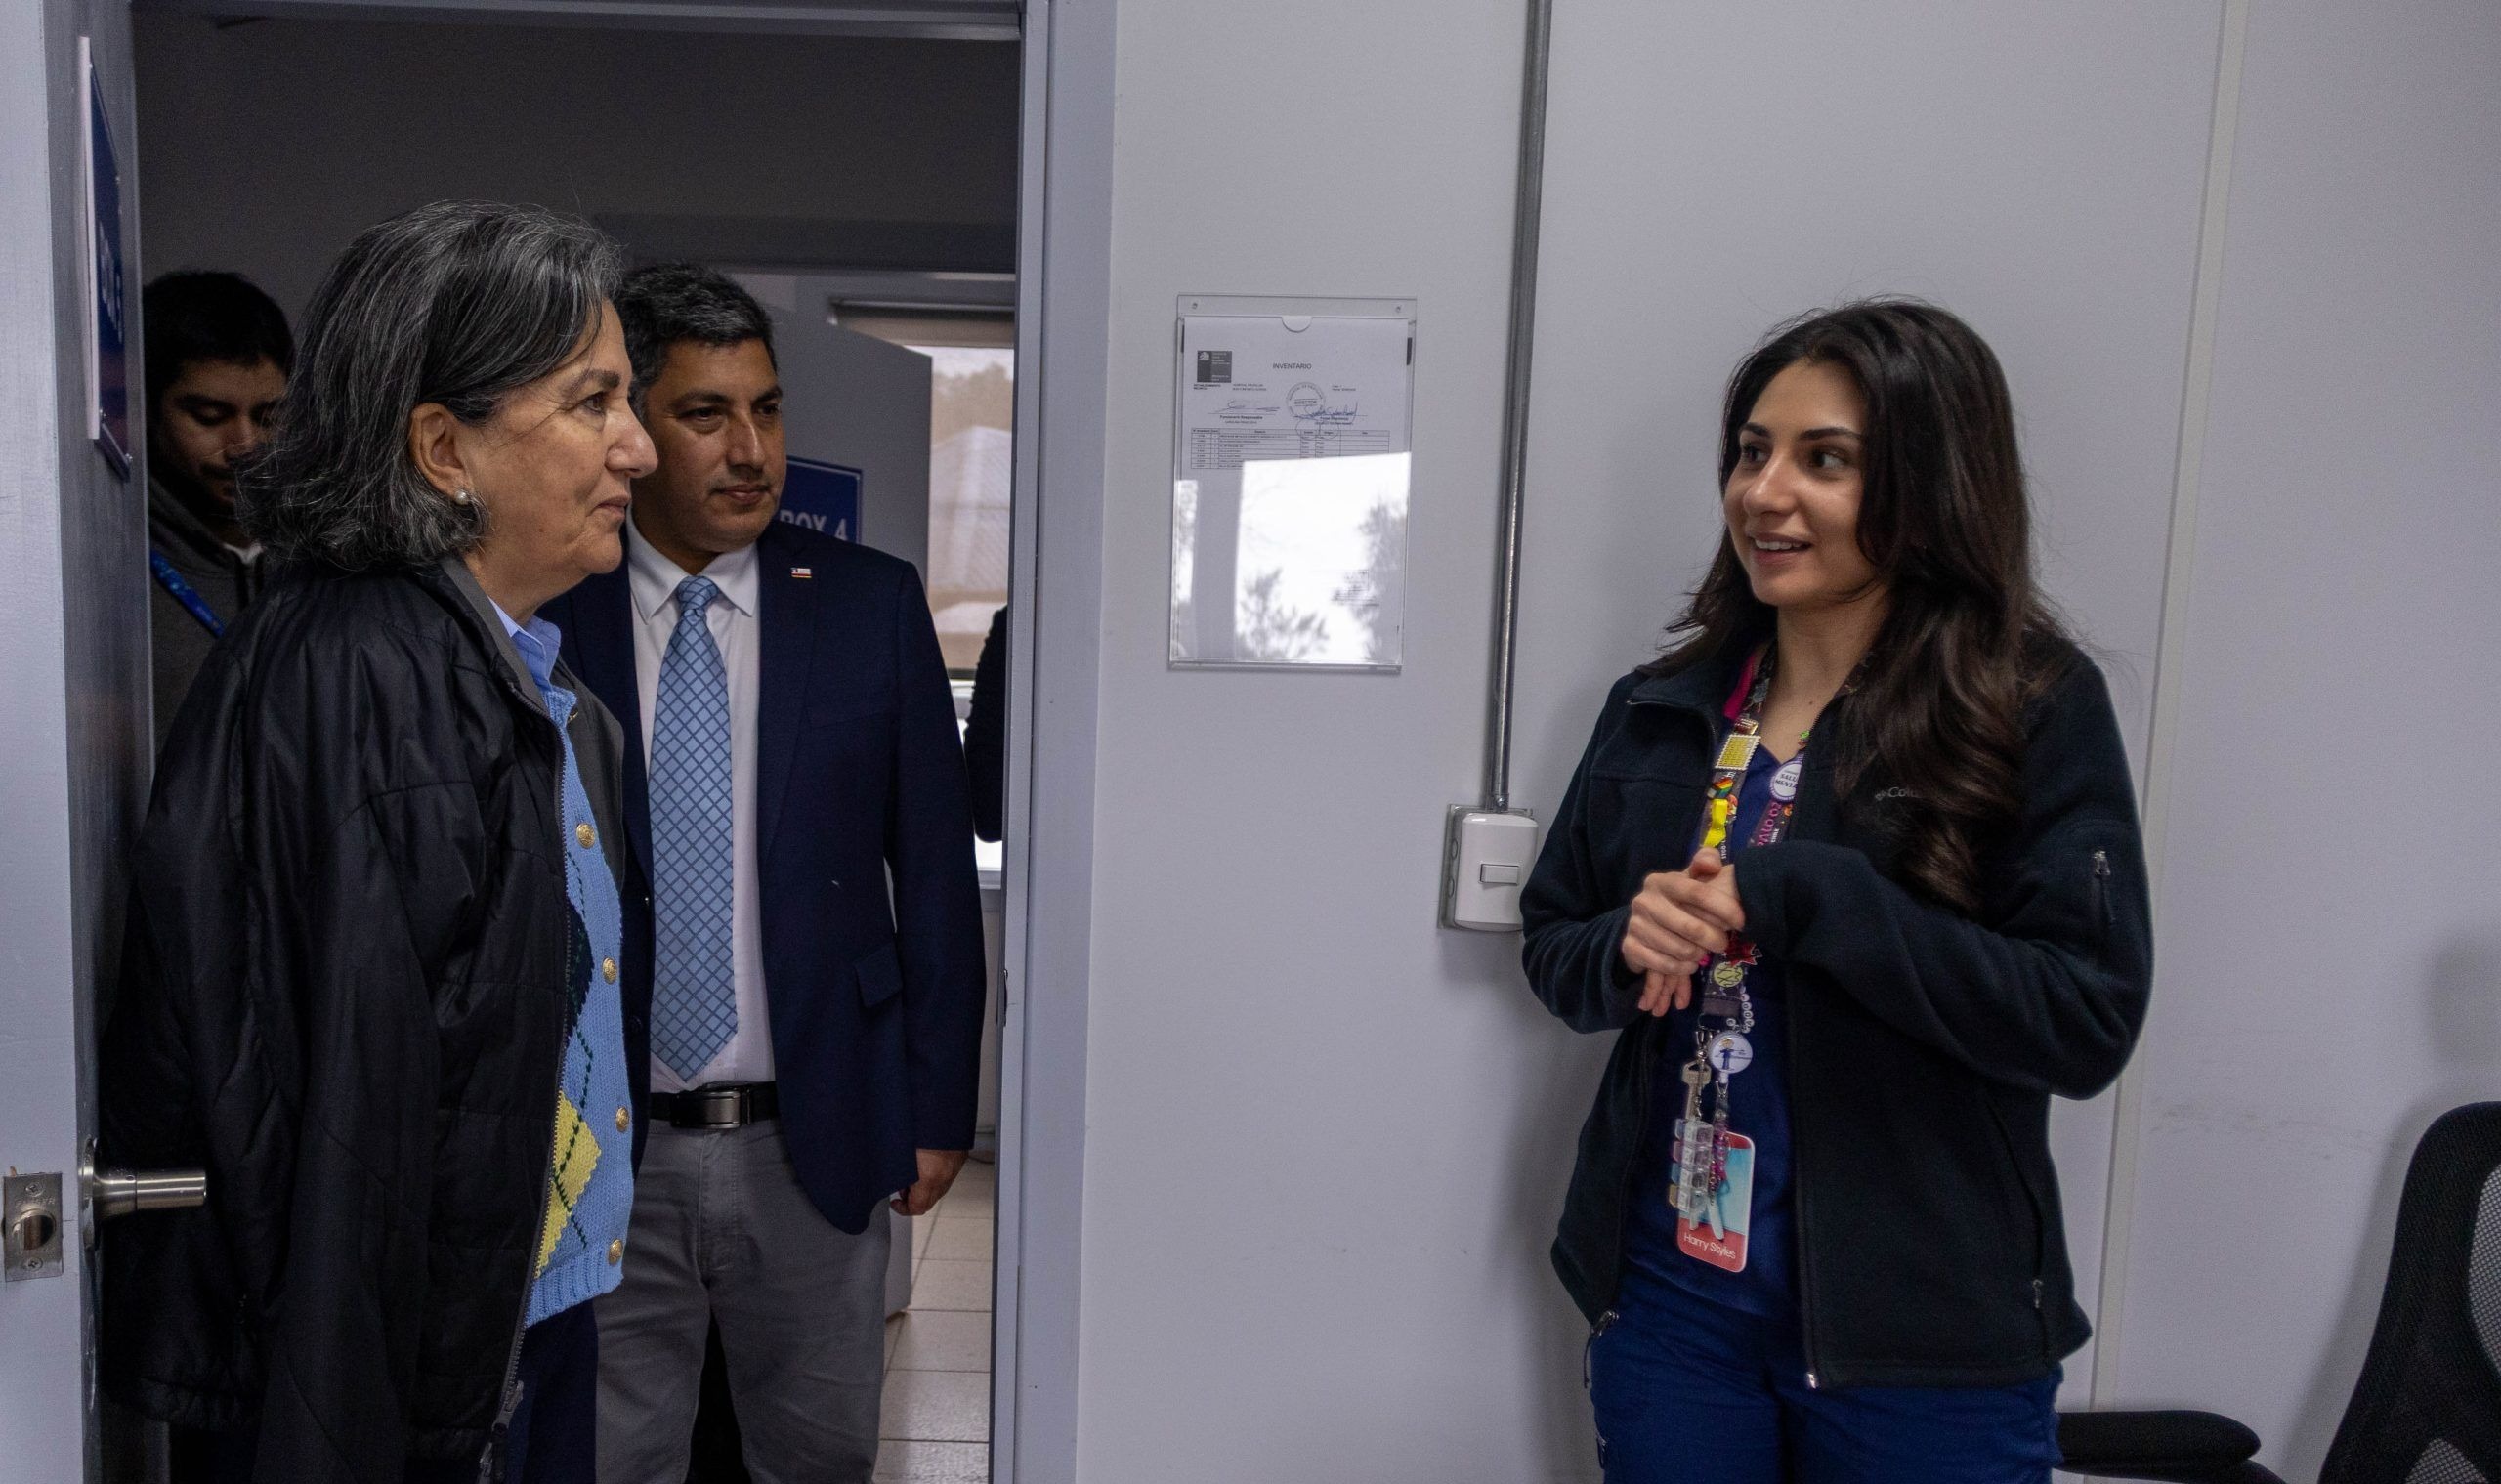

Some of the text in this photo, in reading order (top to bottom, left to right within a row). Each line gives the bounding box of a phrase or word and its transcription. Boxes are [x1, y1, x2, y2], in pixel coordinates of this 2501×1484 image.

[834, 518, 848, 540] 4
[1780, 773, 1798, 783] SALU
[1683, 1232, 1736, 1259] Harry Styles
